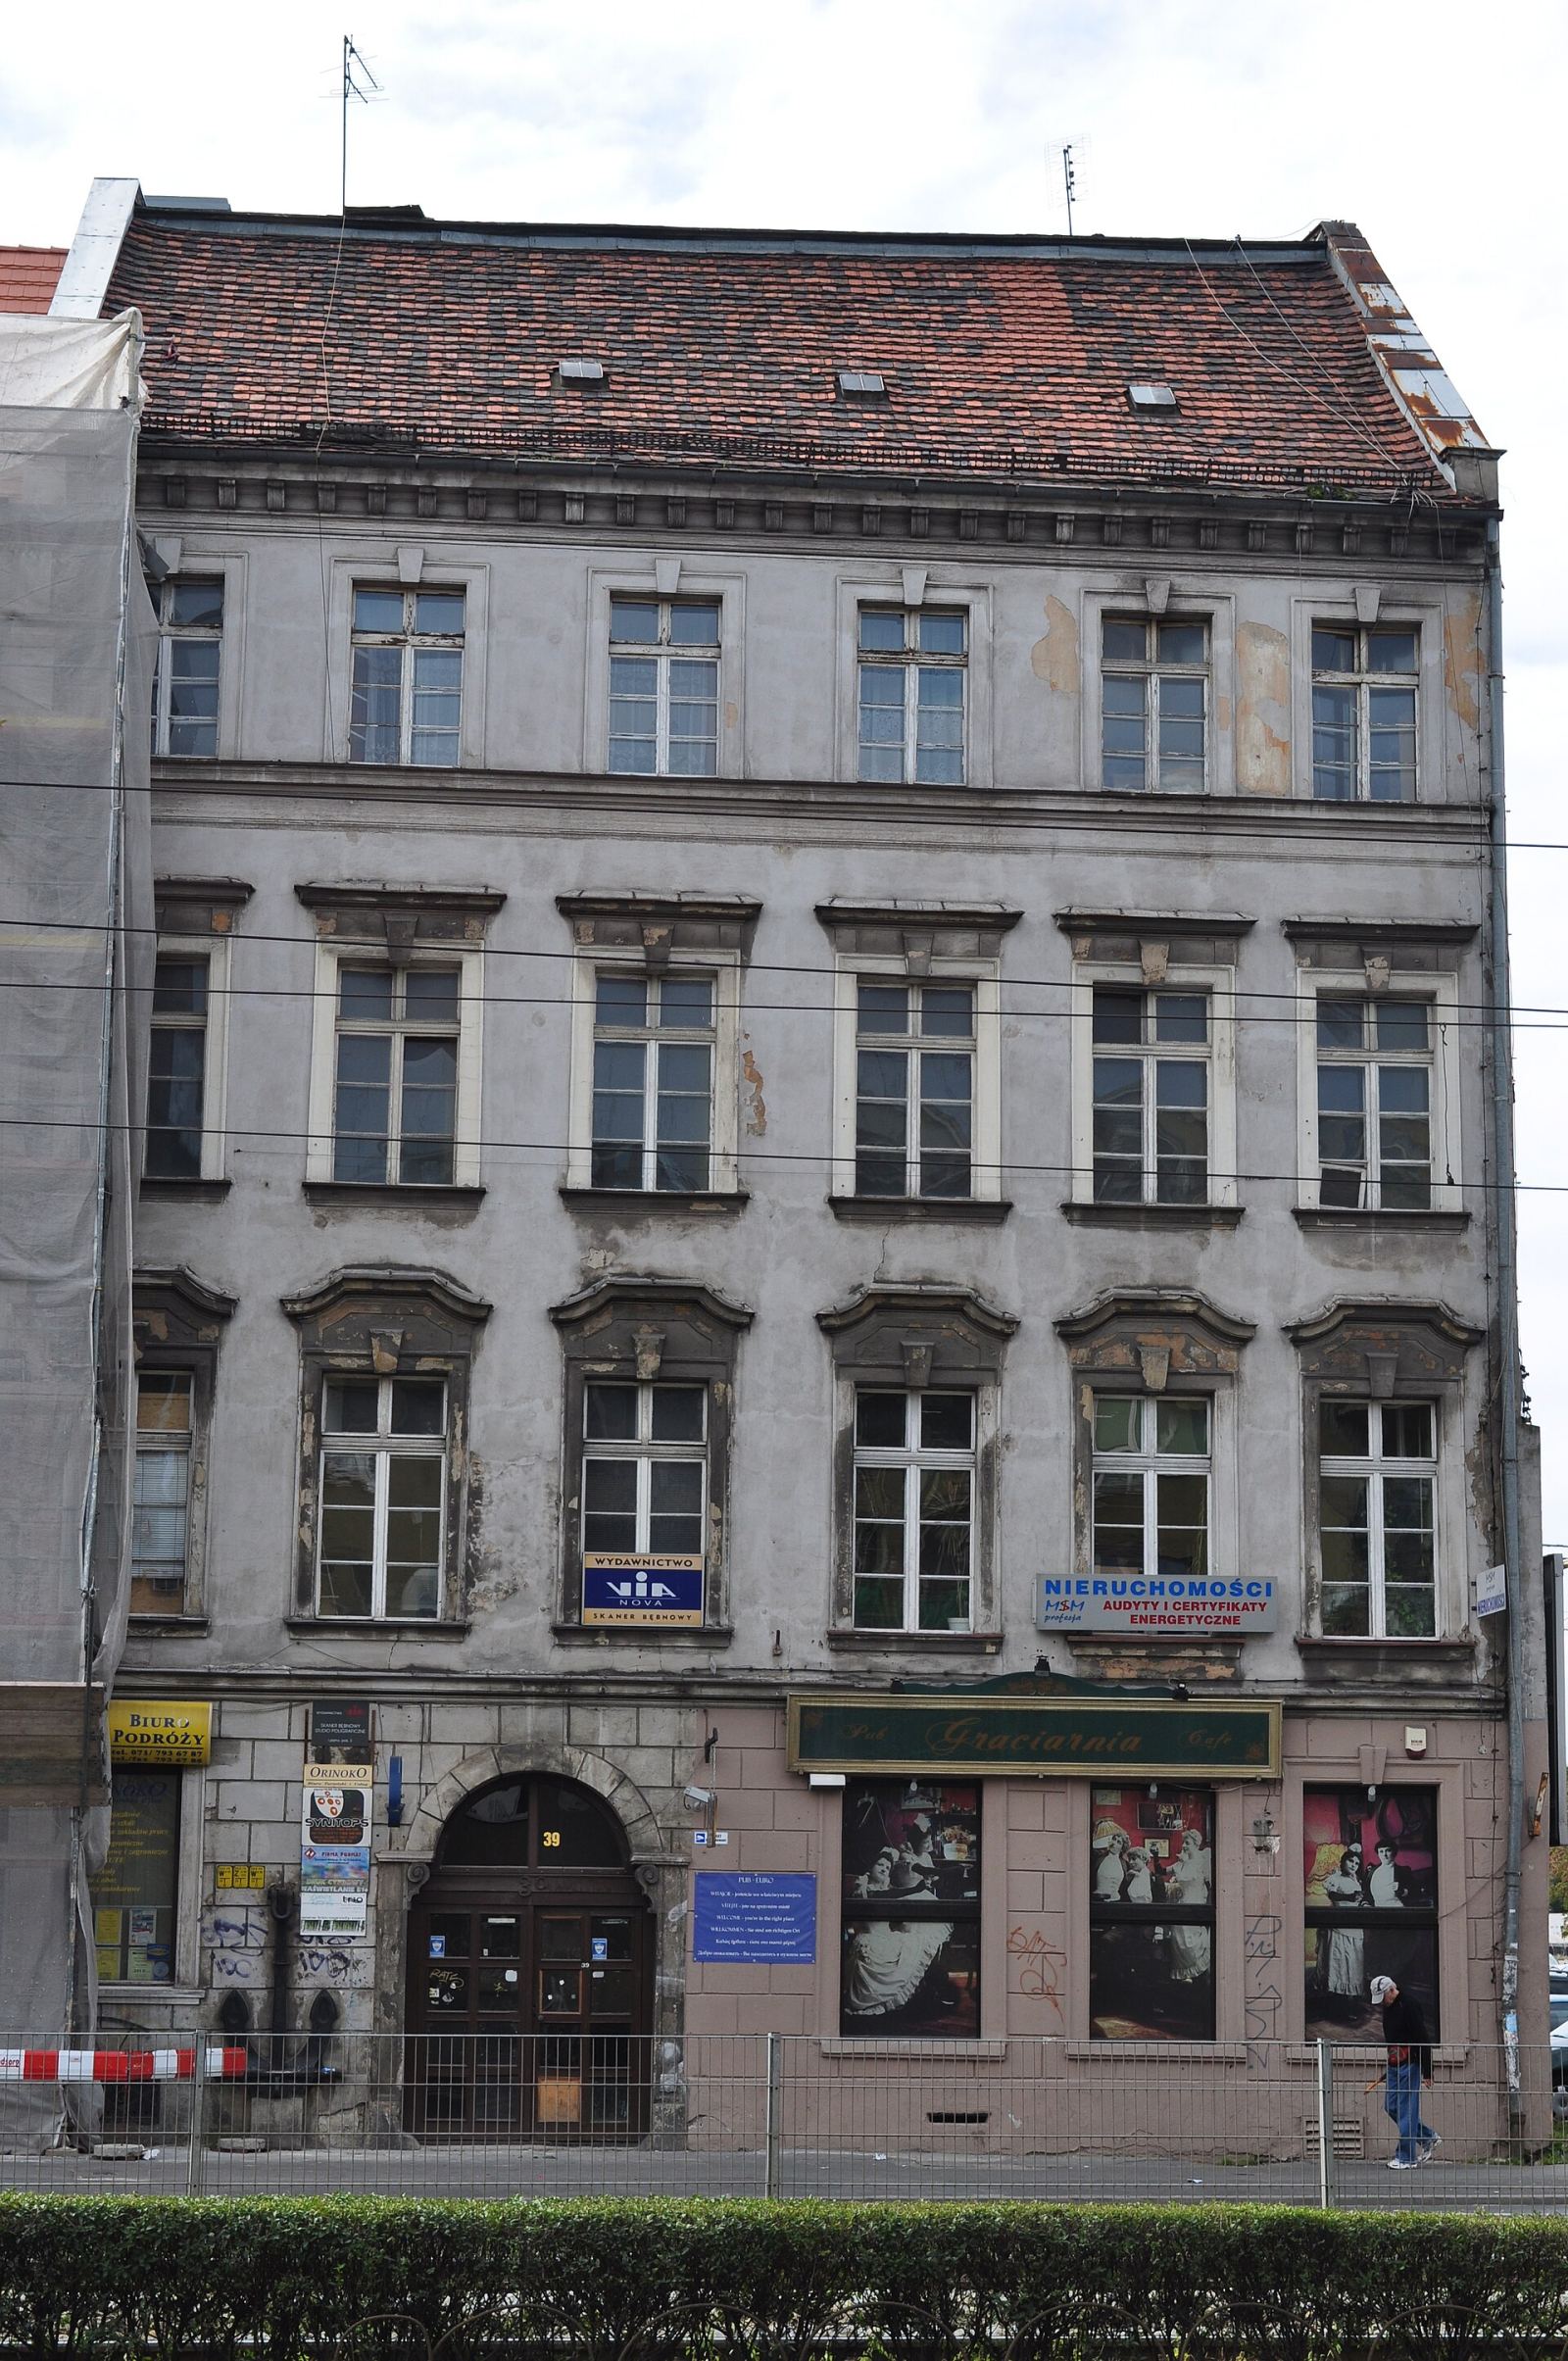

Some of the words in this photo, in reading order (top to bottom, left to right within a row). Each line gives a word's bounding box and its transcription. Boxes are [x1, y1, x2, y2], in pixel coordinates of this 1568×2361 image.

[595, 1557, 693, 1567] WYDAWNICTWO
[1045, 1578, 1272, 1598] NIERUCHOMOŚCI
[1102, 1600, 1159, 1611] AUDYTY
[1163, 1601, 1169, 1611] I
[1172, 1600, 1267, 1612] CERTYFIKATY
[1130, 1614, 1241, 1625] ENERGETYCZNE
[130, 1713, 190, 1728] BIURO
[114, 1729, 205, 1746] PODRÓŻY
[311, 1767, 368, 1778] ORINOKO
[543, 1831, 561, 1846] 39
